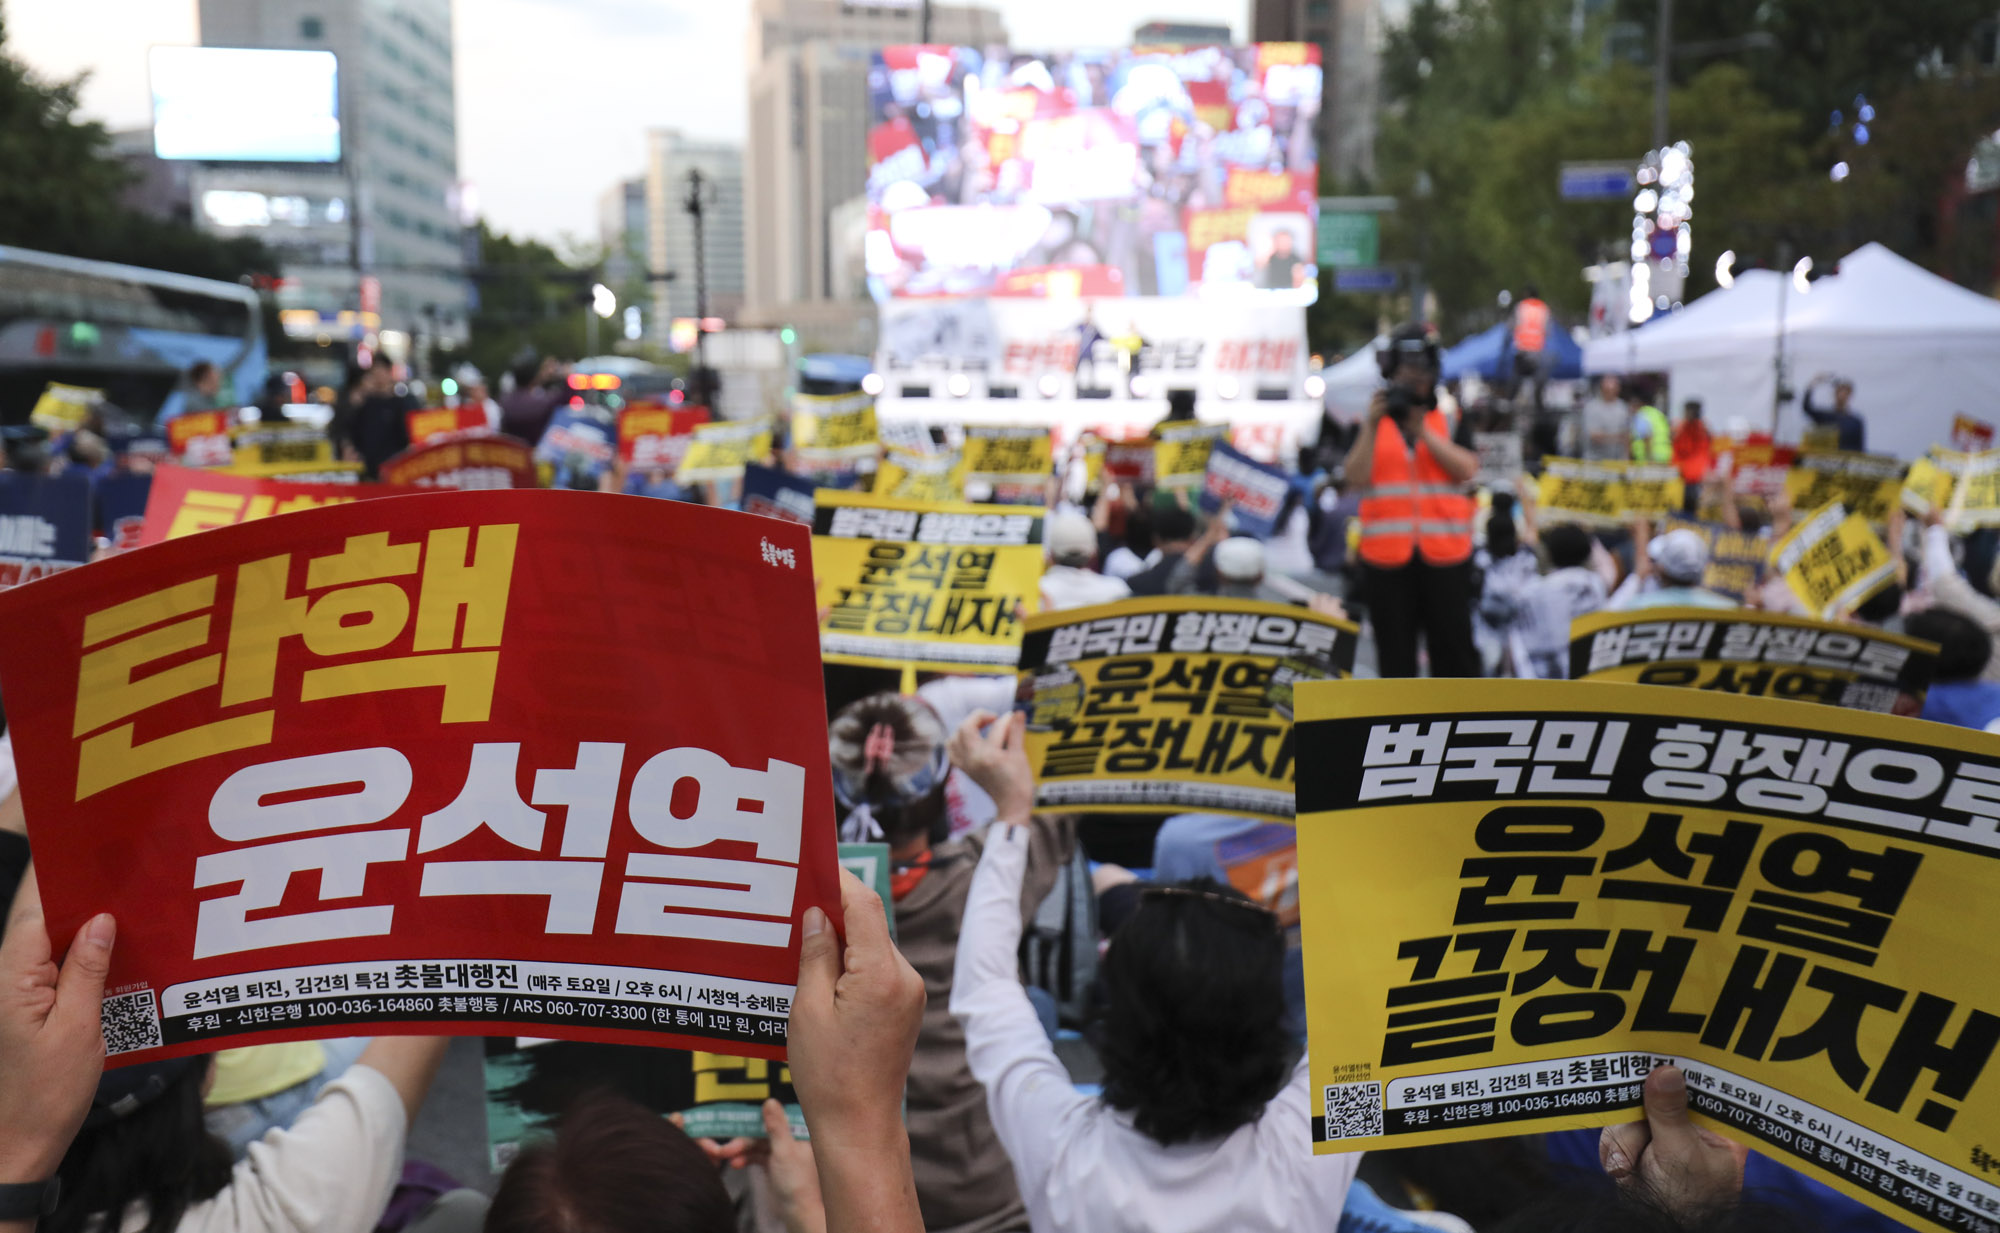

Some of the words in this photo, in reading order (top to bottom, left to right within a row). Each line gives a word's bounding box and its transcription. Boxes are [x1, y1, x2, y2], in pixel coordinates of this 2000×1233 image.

[860, 542, 997, 590] 윤석열
[72, 523, 520, 803] 탄핵
[1045, 613, 1168, 664] 범국민
[1170, 611, 1337, 662] 항쟁으로
[1587, 621, 1715, 673] 범국민
[1719, 622, 1911, 680] 항쟁으로
[1085, 655, 1272, 718] 윤석열
[1041, 719, 1295, 782] 끝장내자
[1358, 719, 1629, 802] 범국민
[1641, 723, 2000, 852] 항쟁으로
[193, 741, 805, 960] 윤석열
[1452, 805, 1924, 967] 윤석열
[184, 985, 240, 1010] 윤석열
[246, 980, 290, 999] 퇴진,
[295, 973, 349, 994] 김건희
[354, 971, 390, 990] 특검
[394, 964, 519, 989] 촛불대행진
[527, 974, 562, 992] (매주
[567, 977, 611, 995] 토요일
[615, 980, 620, 996] /
[625, 981, 655, 998] 오후
[658, 984, 682, 1001] 6시
[686, 986, 692, 1002] /
[697, 988, 790, 1014] 시청역-숭례문
[187, 1013, 220, 1033] 후원
[237, 1003, 302, 1025] 신한은행
[308, 998, 434, 1018] 100-036-164860
[438, 997, 498, 1013] 촛불행동
[503, 998, 508, 1014] /
[513, 1001, 543, 1014] ARS
[547, 1001, 647, 1021] 060-707-3300
[652, 1006, 671, 1025] (한
[676, 1009, 703, 1028] 통에
[709, 1015, 731, 1031] 1만
[736, 1018, 755, 1036] 원,
[759, 1021, 788, 1038] 여러
[1380, 928, 2000, 1132] 끝장내자!
[1403, 1084, 1446, 1103] 윤석열
[1452, 1080, 1484, 1097] 퇴진,
[1489, 1073, 1530, 1093] 김건희
[1536, 1070, 1563, 1087] 특검
[1683, 1068, 1715, 1089] (매주
[1719, 1082, 1762, 1108] 토요일
[1765, 1100, 1772, 1113] /
[1775, 1103, 1804, 1125] 오후
[1808, 1118, 1832, 1139] 6시
[1834, 1130, 1842, 1144] /
[1845, 1134, 1943, 1190] 시청역-숭례문
[1404, 1109, 1430, 1125] 후원
[1442, 1103, 1494, 1122] 신한은행
[1498, 1090, 1601, 1114] 100-036-164860
[1605, 1083, 1645, 1104] 촛불행
[1697, 1094, 1792, 1143] 060-707-3300
[1795, 1135, 1815, 1154] (한
[1818, 1145, 1848, 1171] 통에
[1851, 1161, 1876, 1183] 1만
[1879, 1174, 1898, 1197] 원,
[1902, 1186, 1936, 1212] 여러
